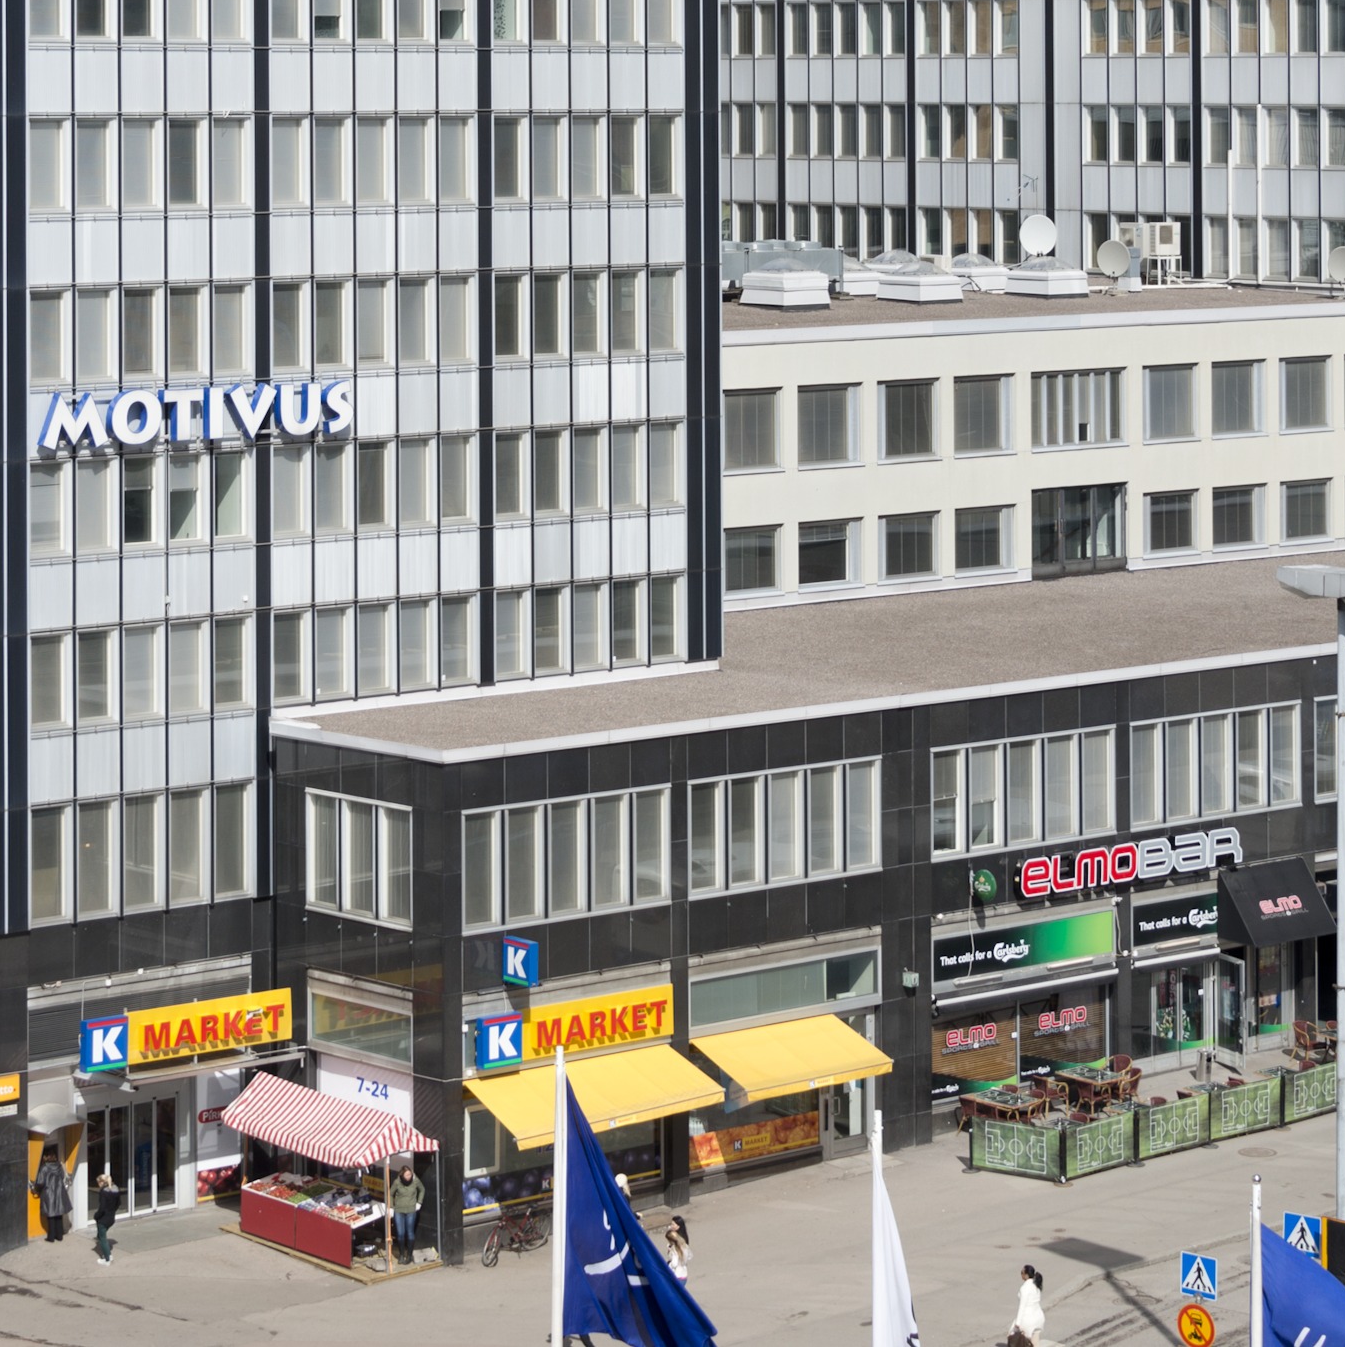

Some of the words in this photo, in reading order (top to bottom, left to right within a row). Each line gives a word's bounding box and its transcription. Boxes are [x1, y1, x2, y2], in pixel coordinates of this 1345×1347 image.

[37, 380, 354, 451] MOTIVUS
[1139, 920, 1155, 932] That
[1156, 917, 1171, 928] calls
[1172, 916, 1181, 926] for
[507, 946, 527, 979] K
[940, 955, 958, 966] That
[958, 952, 974, 963] calls
[975, 950, 986, 960] for
[993, 939, 1030, 963] Carlsberg
[92, 1025, 123, 1064] K
[144, 1004, 285, 1052] MARKET
[489, 1022, 518, 1060] K
[537, 1000, 668, 1049] MARKET
[356, 1077, 389, 1100] 7-24
